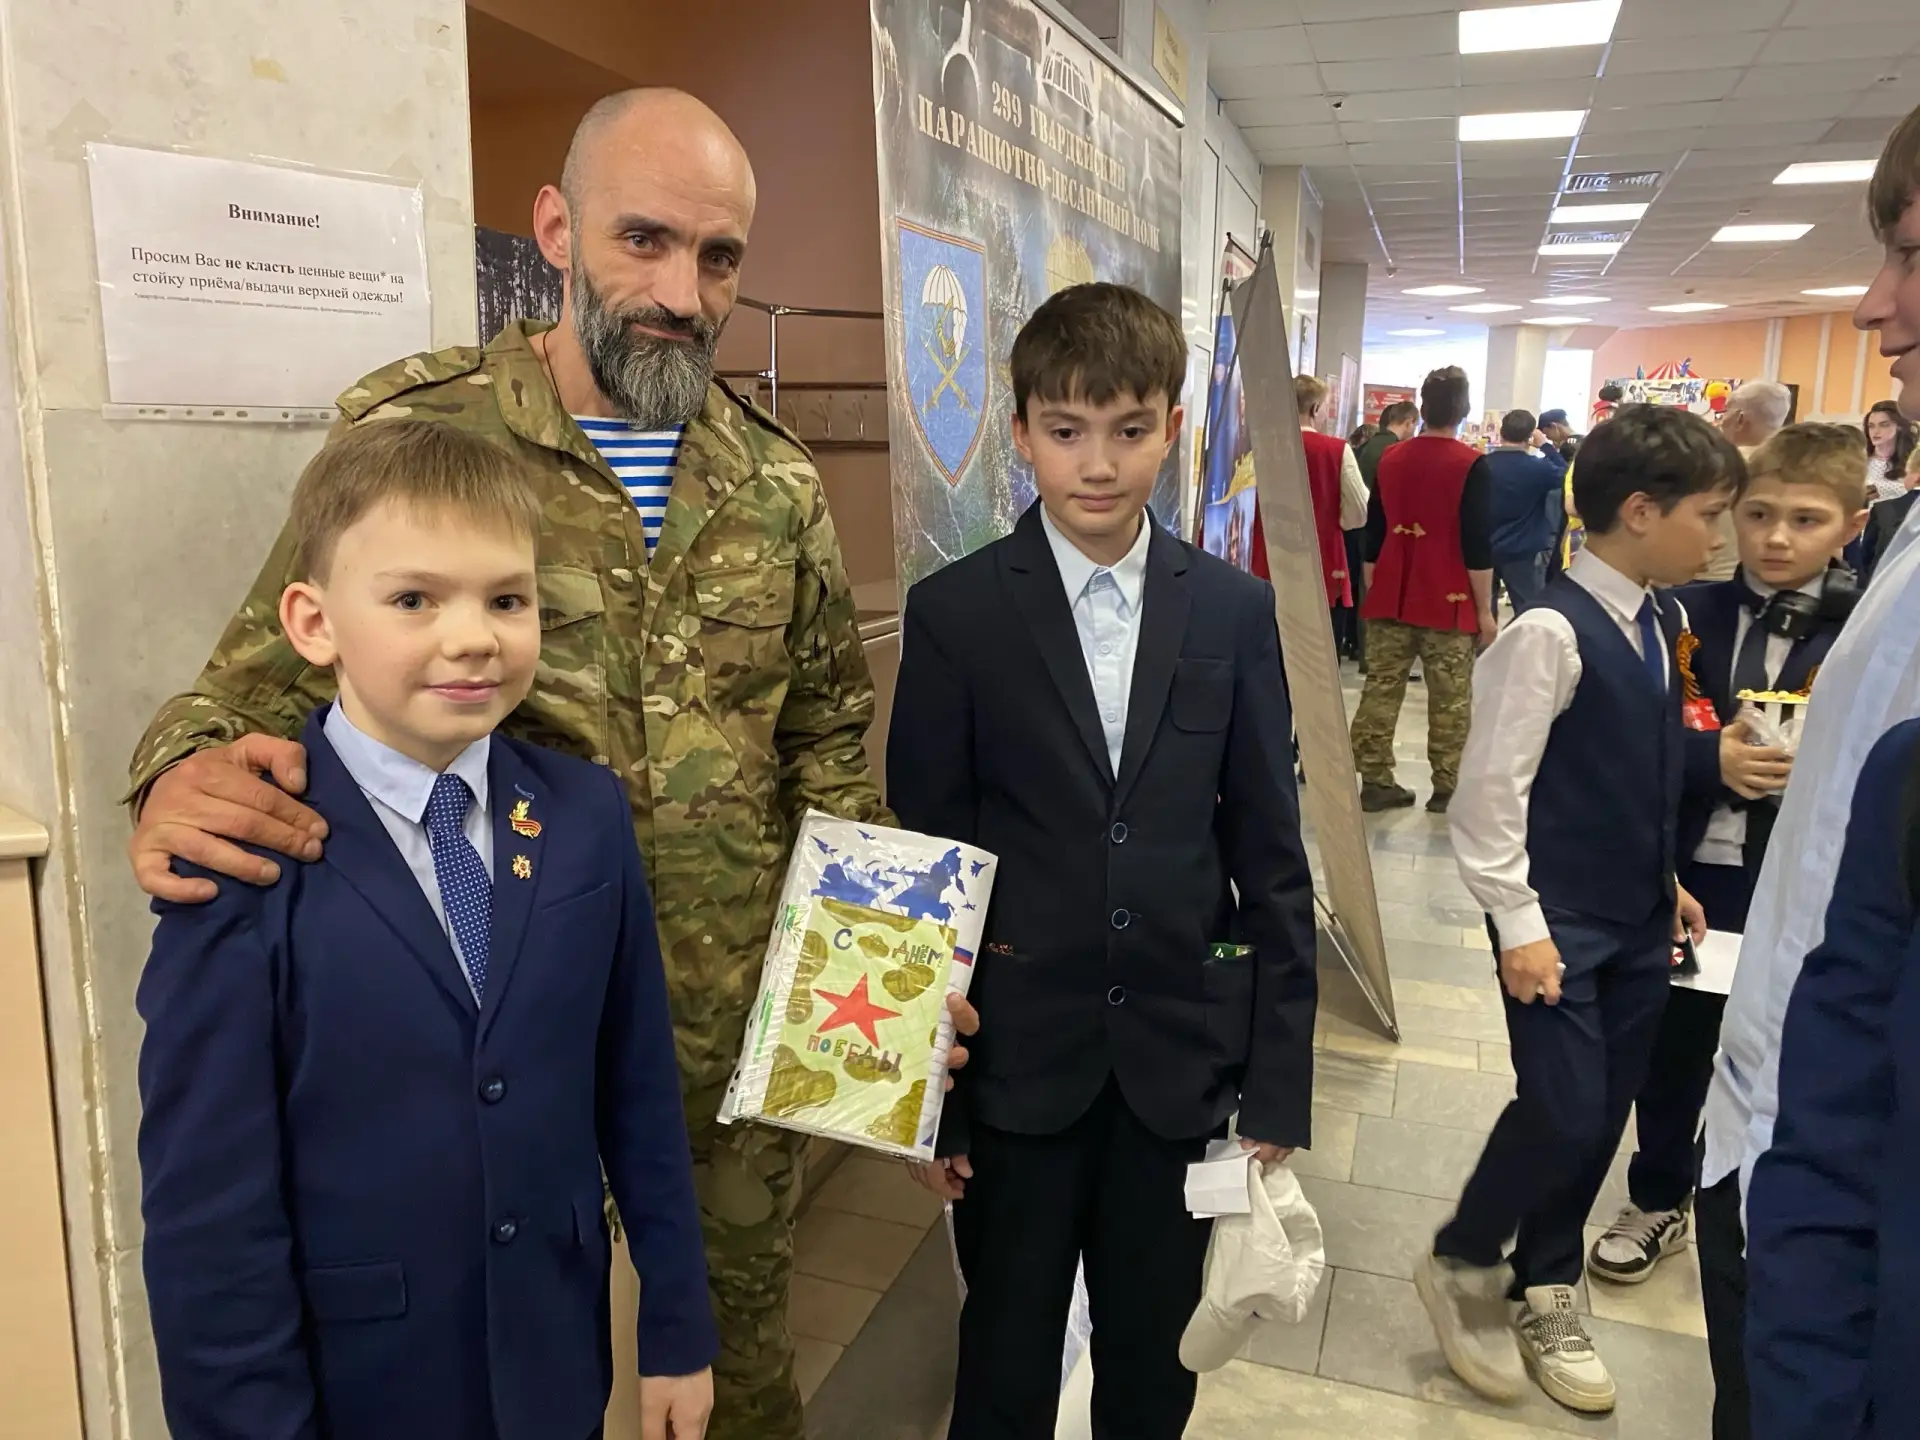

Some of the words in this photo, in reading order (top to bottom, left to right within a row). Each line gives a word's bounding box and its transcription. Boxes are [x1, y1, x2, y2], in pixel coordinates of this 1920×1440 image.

[991, 81, 1022, 129] 299
[1029, 103, 1126, 192] ГВАРДЕЙСКИЙ
[918, 93, 1131, 236] ПАРАШЮТНО-ДЕСАНТНЫЙ
[1132, 213, 1161, 252] ПОЛК
[228, 203, 320, 229] Внимание!
[131, 247, 190, 265] Просим
[195, 253, 220, 267] Вас
[225, 258, 242, 270] не
[246, 260, 295, 275] класть
[299, 265, 345, 280] ценные
[391, 274, 404, 284] на
[132, 270, 184, 289] стойку
[189, 275, 294, 296] приёма/выдачи
[298, 285, 349, 302] верхней
[352, 290, 404, 304] одежды!
[833, 928, 852, 950] С
[806, 1034, 903, 1073] ПОБЕДЫ
